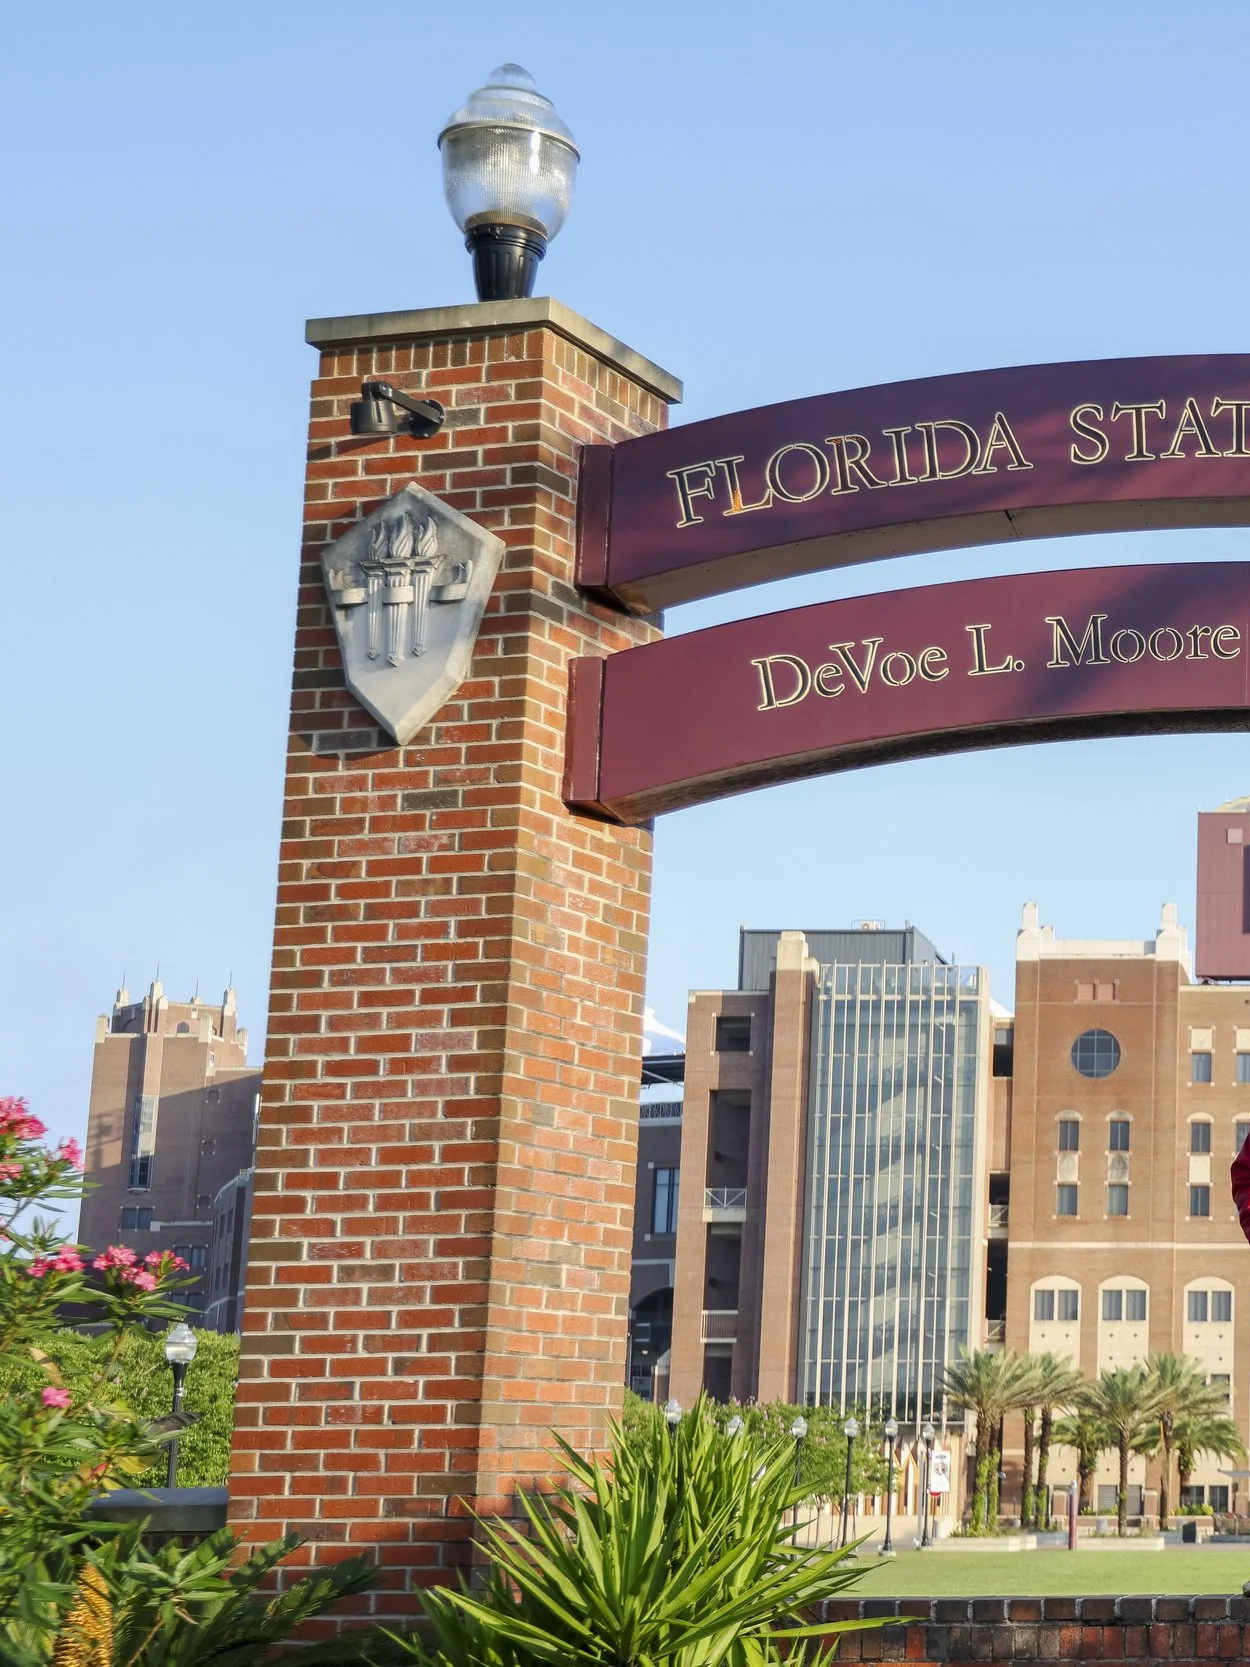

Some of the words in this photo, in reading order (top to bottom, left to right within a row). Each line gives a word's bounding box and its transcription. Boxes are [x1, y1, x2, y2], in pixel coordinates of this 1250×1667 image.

[667, 412, 1034, 528] FLORIDA
[751, 637, 950, 712] DeVoe
[965, 624, 1025, 677] L.
[1045, 613, 1241, 668] Moore
